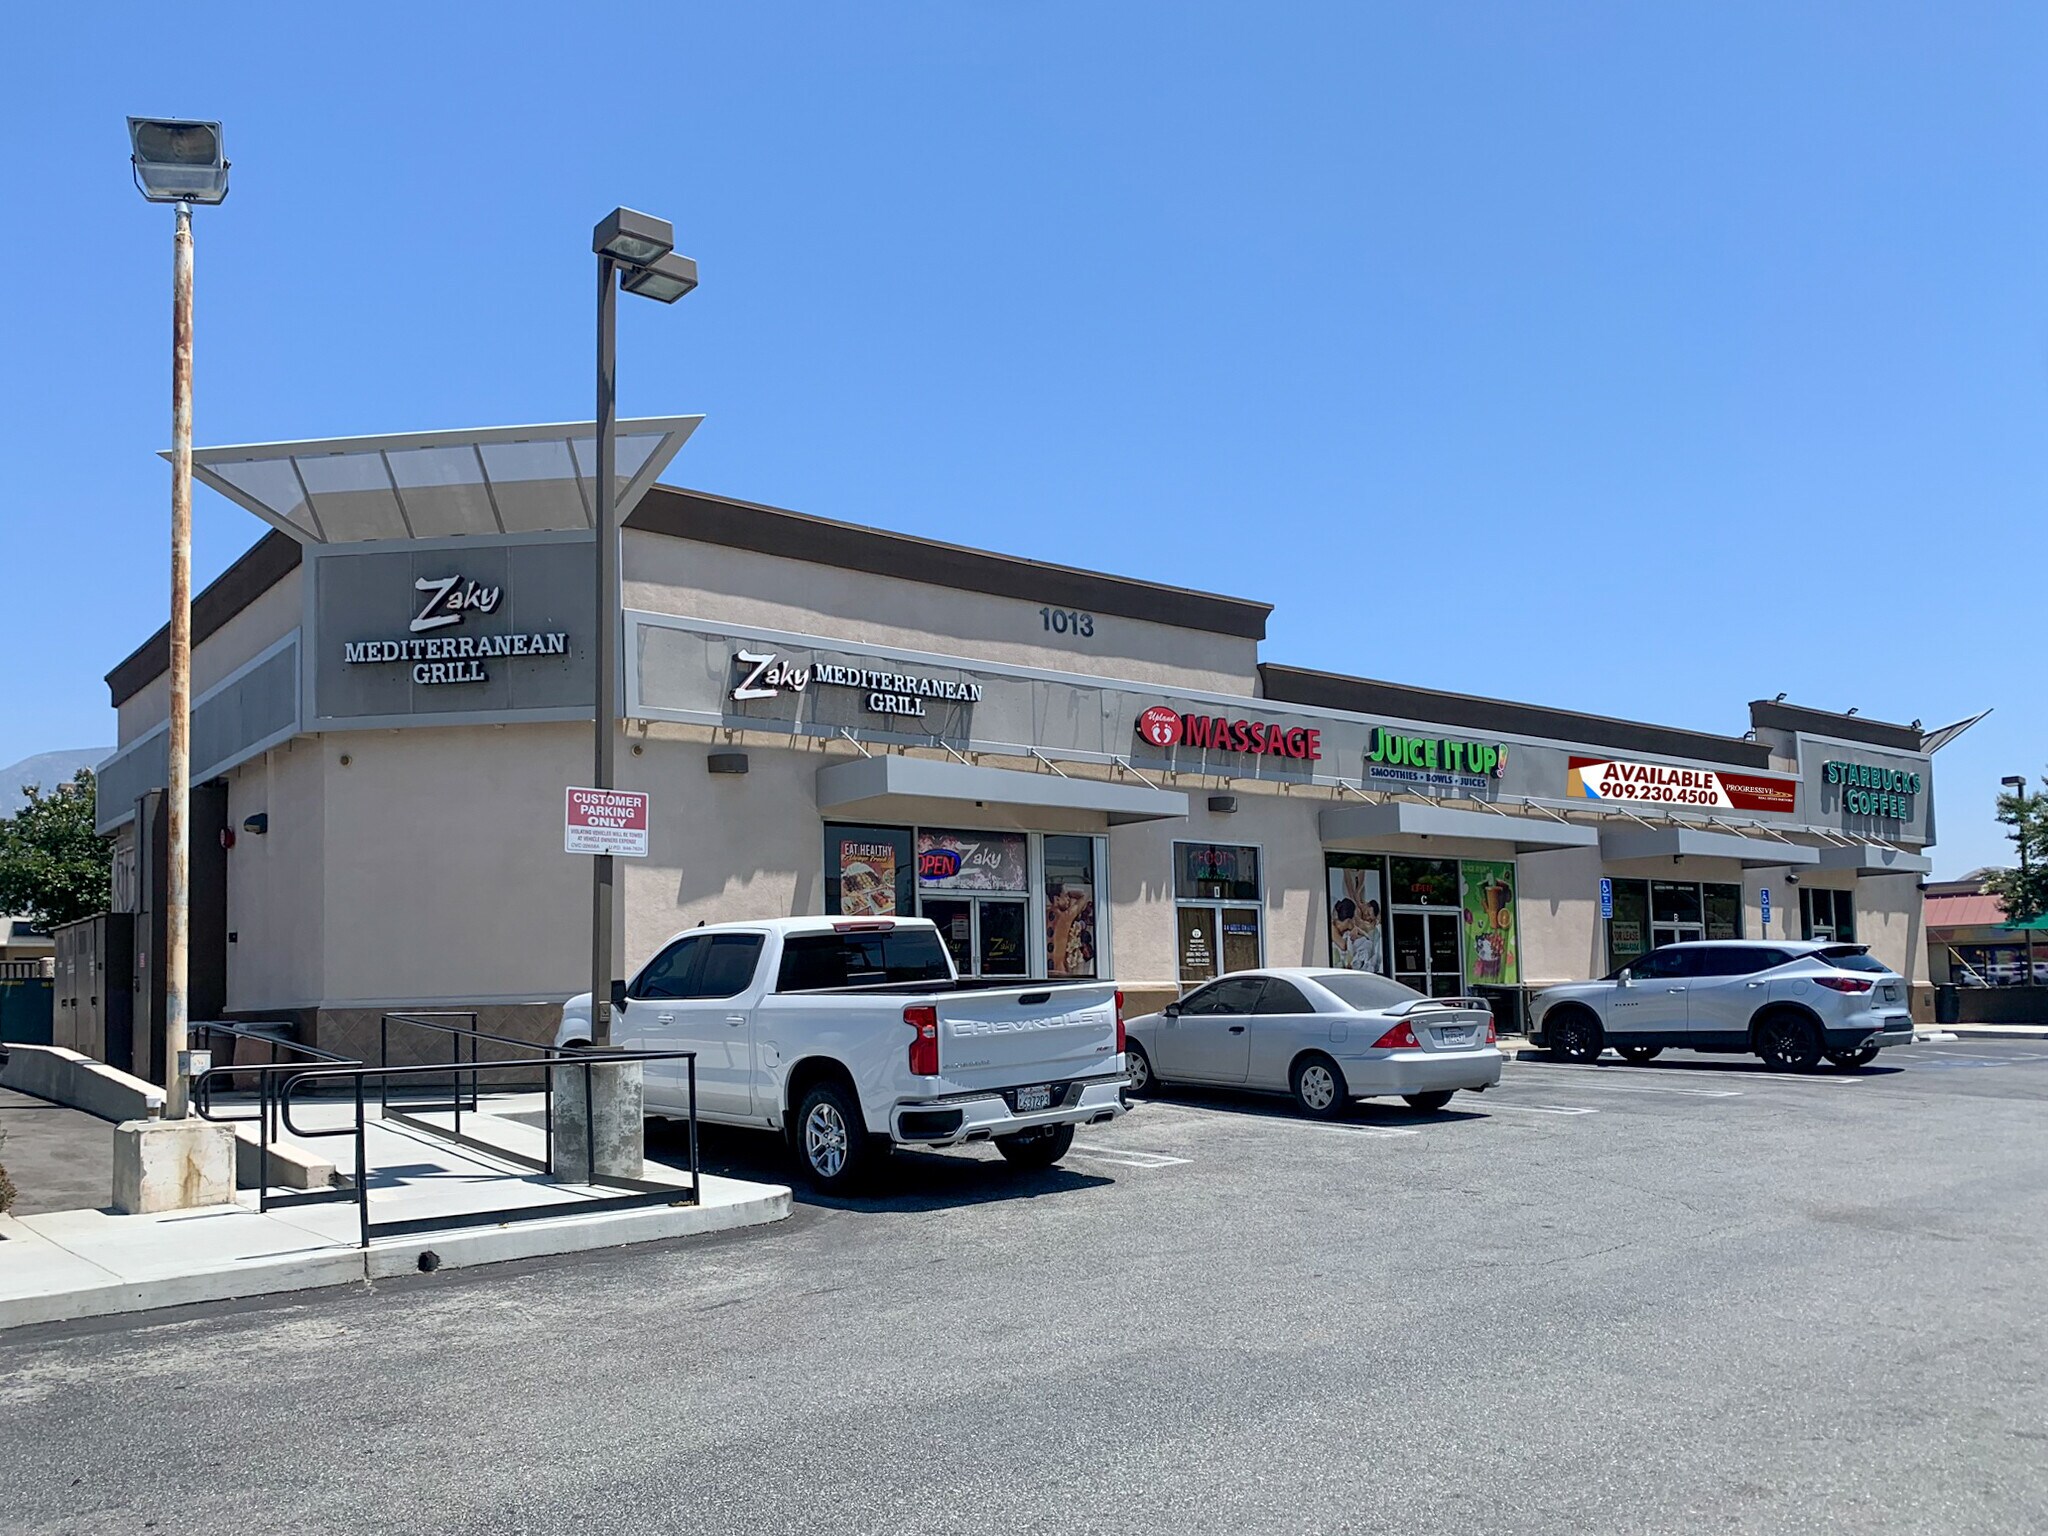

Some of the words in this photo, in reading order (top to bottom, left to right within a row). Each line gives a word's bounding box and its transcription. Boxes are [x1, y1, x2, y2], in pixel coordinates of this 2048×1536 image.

[409, 574, 500, 632] Zaky
[1040, 606, 1093, 638] 1013
[345, 633, 566, 663] MEDITERRANEAN
[412, 661, 486, 684] GRILL
[730, 648, 809, 700] Zaky
[814, 663, 983, 702] MEDITERRANEAN
[870, 693, 926, 717] GRILL
[1147, 711, 1177, 723] Upland
[1184, 713, 1321, 760] MASSAGE
[1368, 725, 1438, 767] JUICE
[1444, 738, 1464, 772] IT
[1370, 767, 1418, 781] SMOOTHIES
[1426, 773, 1453, 785] BOWLS
[1460, 776, 1487, 788] JUICES
[1603, 763, 1713, 790] AVAILABLE
[1726, 783, 1774, 795] PROGRESSIVE
[1826, 759, 1922, 795] STARBUCKS
[573, 792, 642, 808] CUSTOMER
[1600, 781, 1718, 806] 909.230.4500
[1845, 789, 1907, 821] COFFEE
[580, 804, 635, 818] PARKING
[587, 816, 627, 828] ONLY
[844, 843, 859, 855] EAT
[860, 844, 893, 857] HEALTHY
[954, 841, 1002, 877] Zaky
[918, 855, 956, 876] OPEN
[1420, 895, 1428, 905] C
[1673, 913, 1679, 922] B
[953, 1010, 1108, 1038] CHEVROLET
